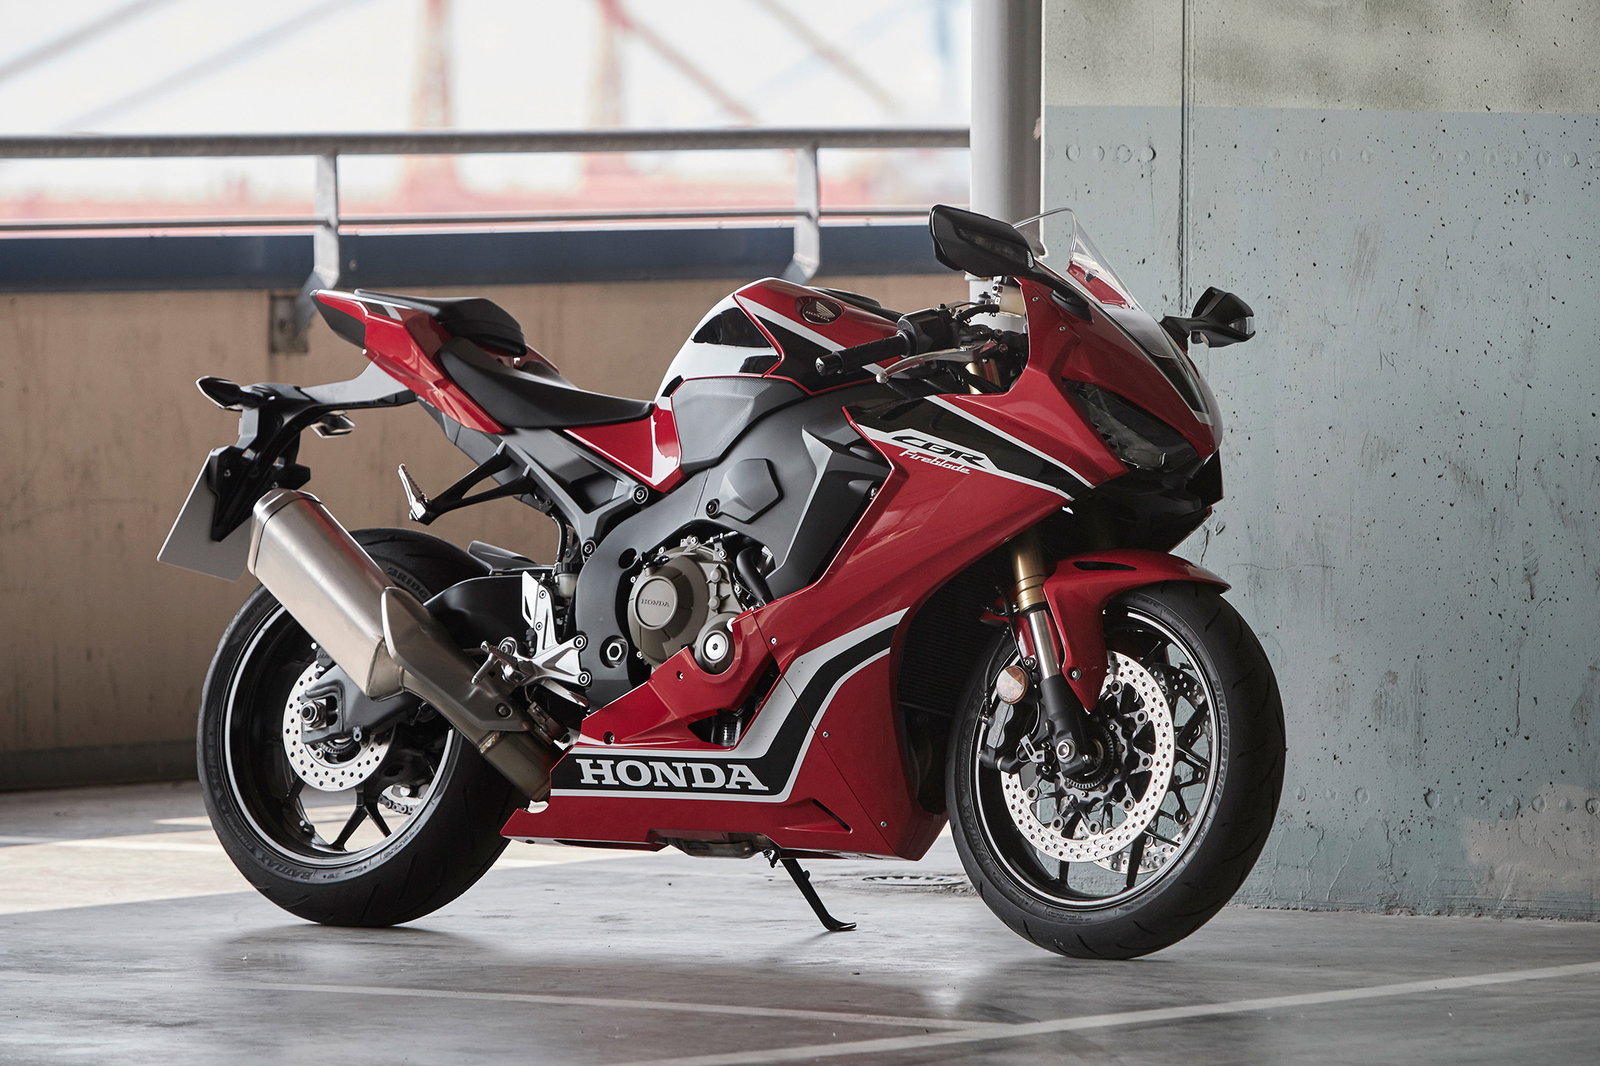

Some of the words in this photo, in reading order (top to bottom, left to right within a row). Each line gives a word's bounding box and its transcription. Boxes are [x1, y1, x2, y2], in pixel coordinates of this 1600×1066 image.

[891, 435, 988, 470] CBR
[899, 448, 971, 475] Fireblade
[640, 598, 670, 608] HONDA
[1213, 679, 1229, 807] BRIDGESTONE
[575, 758, 769, 791] HONDA
